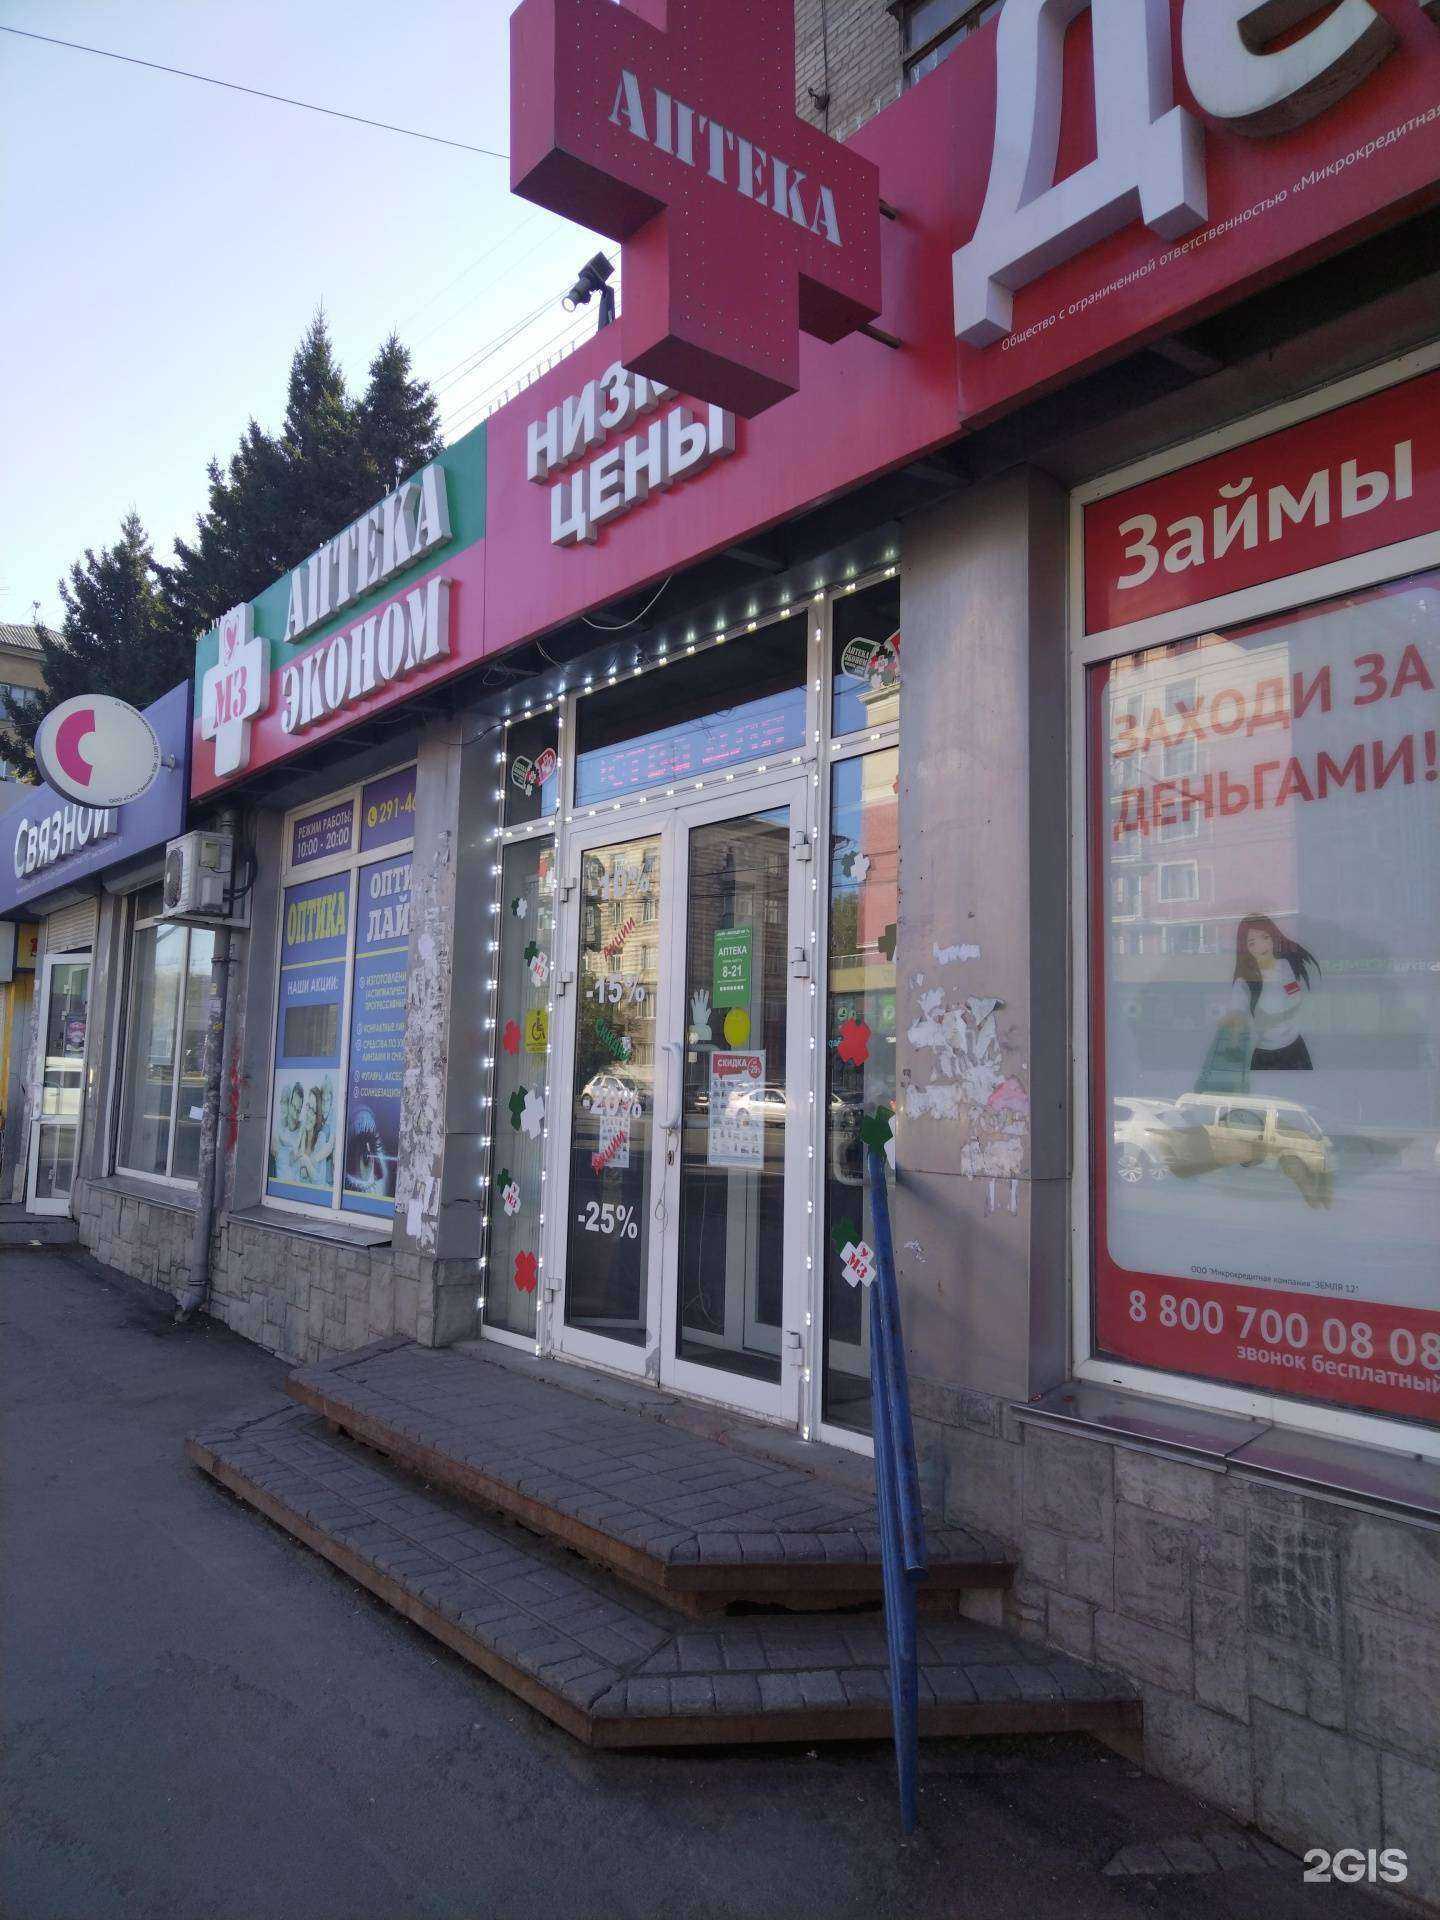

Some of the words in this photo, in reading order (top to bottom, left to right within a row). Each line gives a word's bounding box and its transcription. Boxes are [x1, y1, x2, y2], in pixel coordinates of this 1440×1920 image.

[608, 69, 842, 247] АПТЕКА
[1001, 314, 1056, 352] Общество
[1059, 309, 1066, 320] с
[1068, 259, 1156, 315] ограниченной
[1160, 190, 1288, 266] ответственностью
[551, 403, 730, 546] ЦЕНЫ
[1117, 439, 1413, 590] Займы
[284, 463, 450, 643] АПТЕКА
[282, 575, 450, 734] ЭКОНОМ
[1113, 665, 1332, 760] ЗАХОДИ
[1353, 644, 1435, 706] ЗА
[1113, 730, 1439, 842] ДЕНЬГАМИ!
[298, 820, 322, 839] РЕЖИМ
[298, 837, 319, 858] 10:00
[326, 827, 349, 849] 20:00
[287, 891, 346, 946] ОПТИКА
[718, 945, 748, 957] АПТЕКА
[288, 978, 309, 995] НАШИ
[586, 974, 646, 1003] -15%
[722, 964, 743, 978] 8-21
[577, 1201, 638, 1239] -25%
[1129, 1290, 1147, 1322] 8
[1159, 1294, 1224, 1334] 800
[1236, 1305, 1308, 1348] 700
[1322, 1318, 1374, 1359] 08
[1390, 1328, 1440, 1371] 08
[1236, 1346, 1306, 1370] звонок
